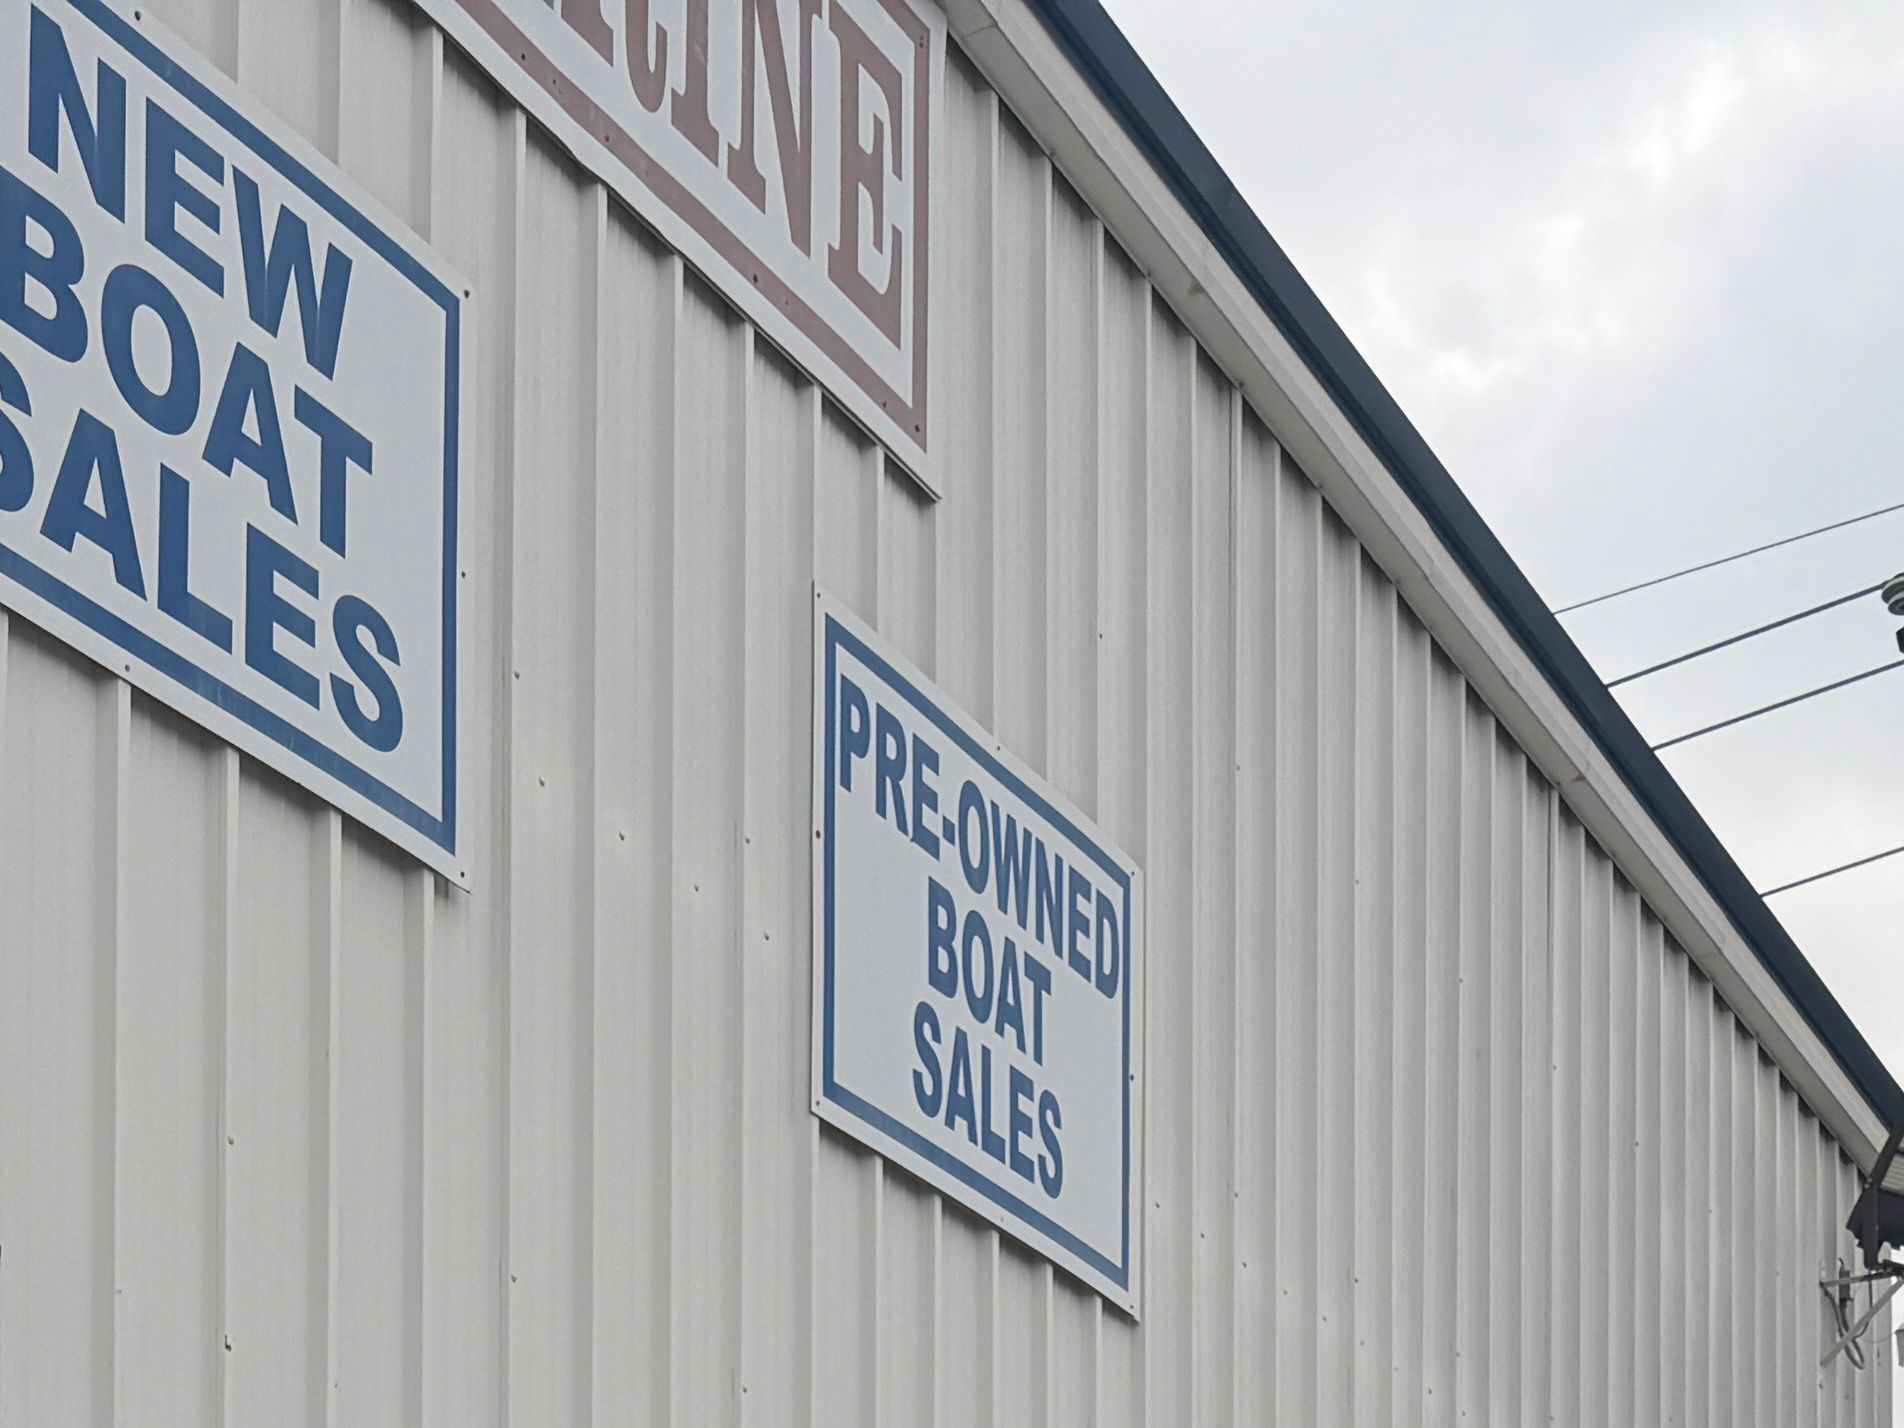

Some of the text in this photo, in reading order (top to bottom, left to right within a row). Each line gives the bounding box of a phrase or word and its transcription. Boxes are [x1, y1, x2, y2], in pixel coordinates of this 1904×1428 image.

[28, 2, 353, 382] NEW
[839, 672, 1120, 1000] PRE-OWNED
[912, 1000, 1064, 1200] SALES
[928, 875, 1052, 1067] BOAT
